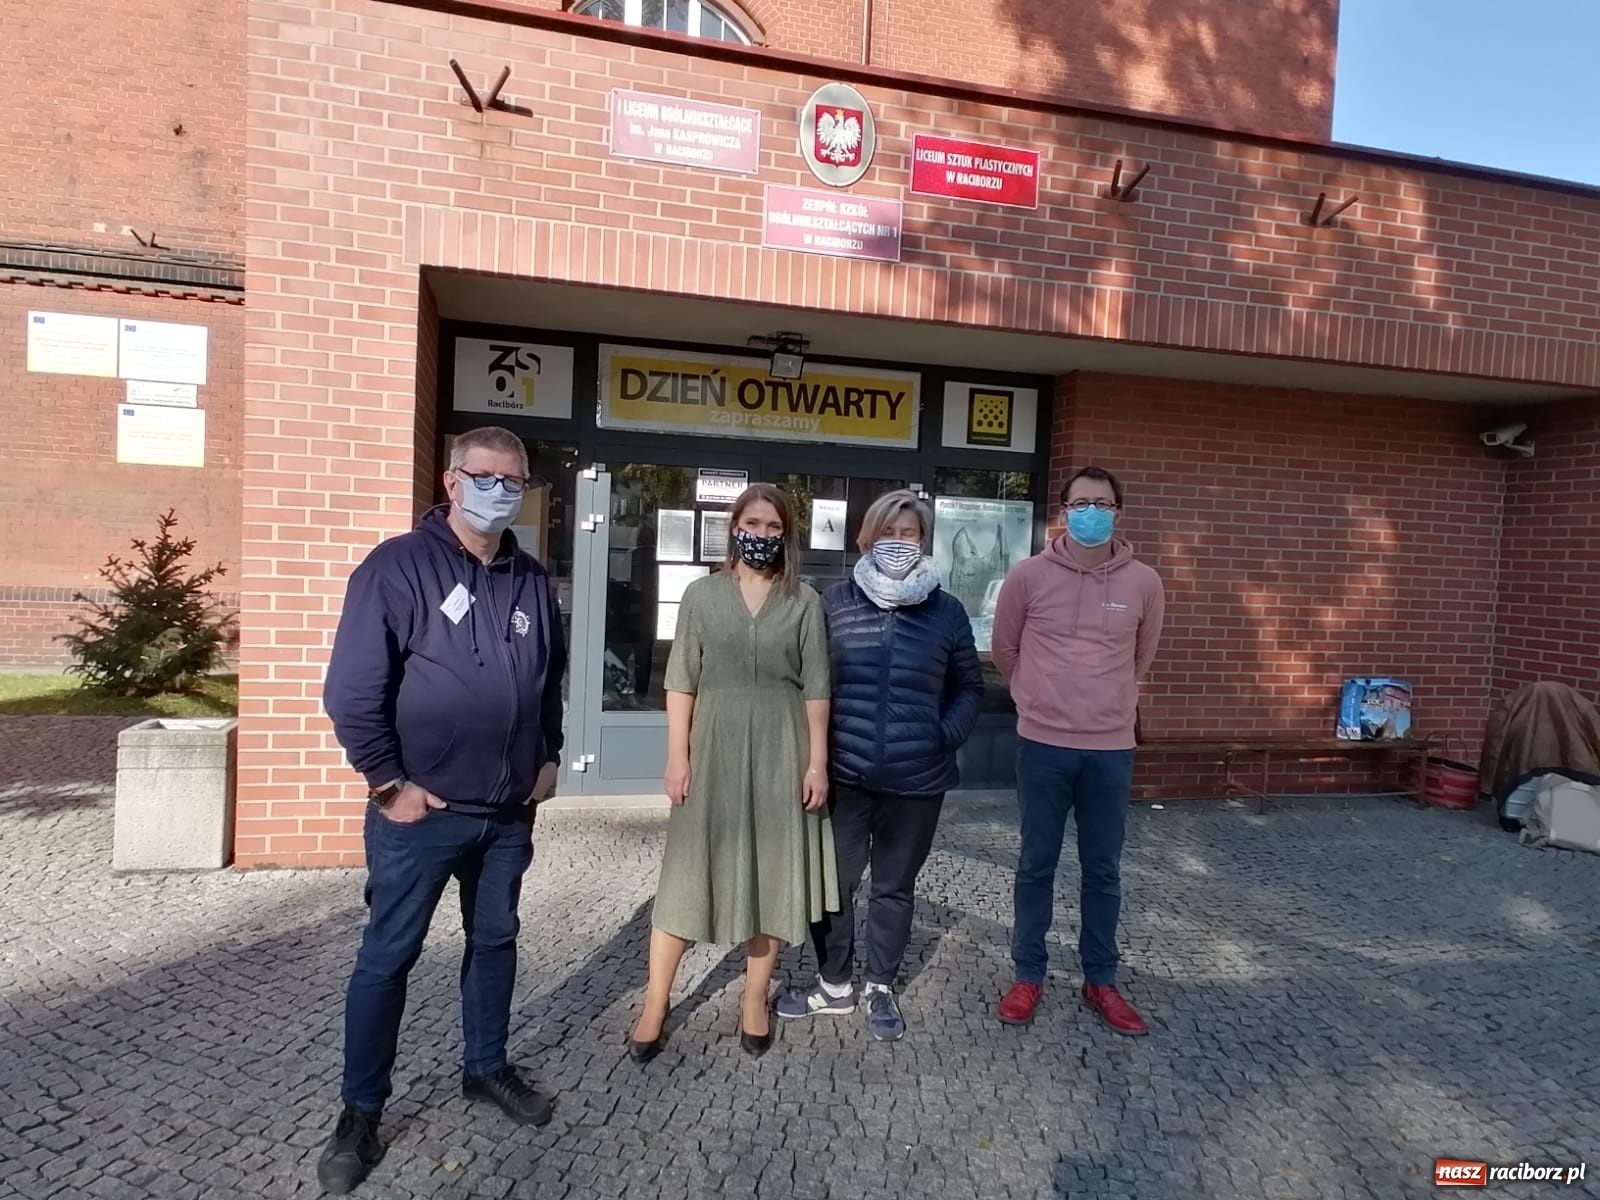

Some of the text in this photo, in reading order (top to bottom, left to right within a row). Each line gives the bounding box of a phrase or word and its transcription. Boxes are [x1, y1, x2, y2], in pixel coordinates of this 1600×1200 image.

[623, 100, 659, 121] LICEUM
[660, 103, 753, 135] OGÓLNOKSZTAŁCĄCE
[647, 124, 671, 139] Jana
[672, 127, 742, 150] KASPROWICZA
[653, 142, 663, 154] W
[916, 148, 1034, 177] LICEUM SZTUK PLASTYCZNYCH
[946, 170, 1003, 190] W RACIBORZU
[802, 197, 869, 217] ZESPÓŁ SZKÓŁ
[768, 210, 875, 236] OGÓLNOKSZTAŁCĄCYCH
[877, 225, 890, 237] NR
[803, 233, 864, 250] W RACIBORZU
[487, 399, 524, 409] Racibórz
[619, 368, 906, 421] DZIEŃ OTWARTY
[710, 409, 821, 433] zapraszamy
[702, 479, 743, 489] PARTNER
[822, 518, 835, 532] A
